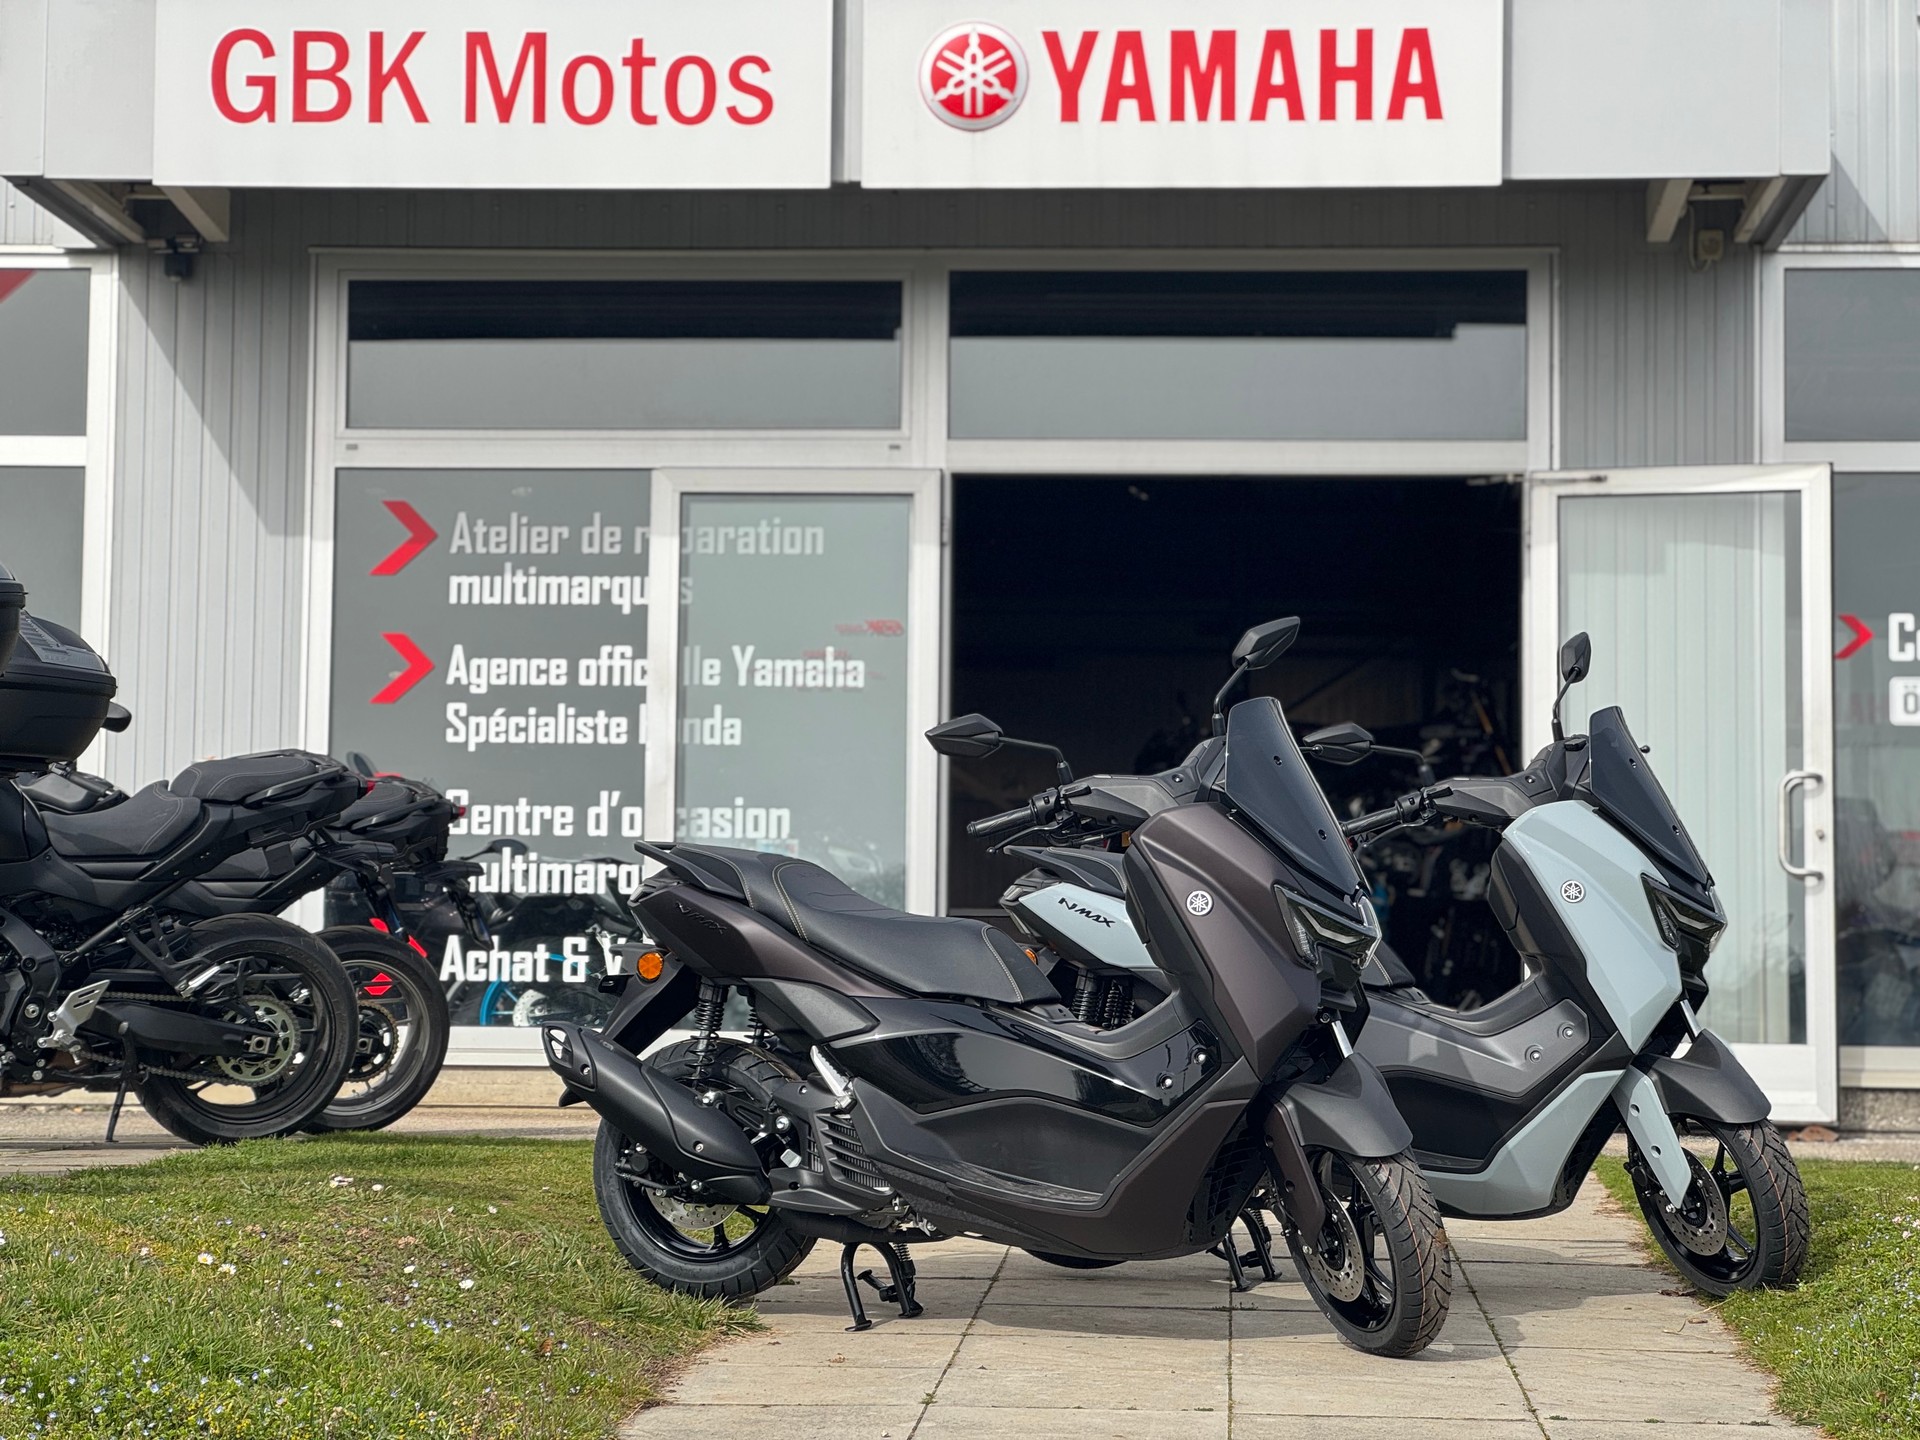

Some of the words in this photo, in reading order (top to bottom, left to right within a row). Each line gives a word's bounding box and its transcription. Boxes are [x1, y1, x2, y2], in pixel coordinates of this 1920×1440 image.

[210, 28, 430, 124] GBK
[463, 31, 774, 126] Motos
[1041, 27, 1444, 123] YAMAHA
[450, 511, 569, 554] Atelier
[581, 511, 621, 554] de
[634, 517, 824, 555] rparation
[449, 561, 693, 615] multimarqus
[1888, 612, 1920, 662] C
[446, 643, 568, 694] Agence
[578, 644, 721, 687] officlle
[731, 645, 865, 688] Yamaha
[446, 702, 628, 752] Spécialiste
[1058, 897, 1116, 928] NMAX
[439, 934, 550, 982] Achat
[562, 936, 590, 983] &
